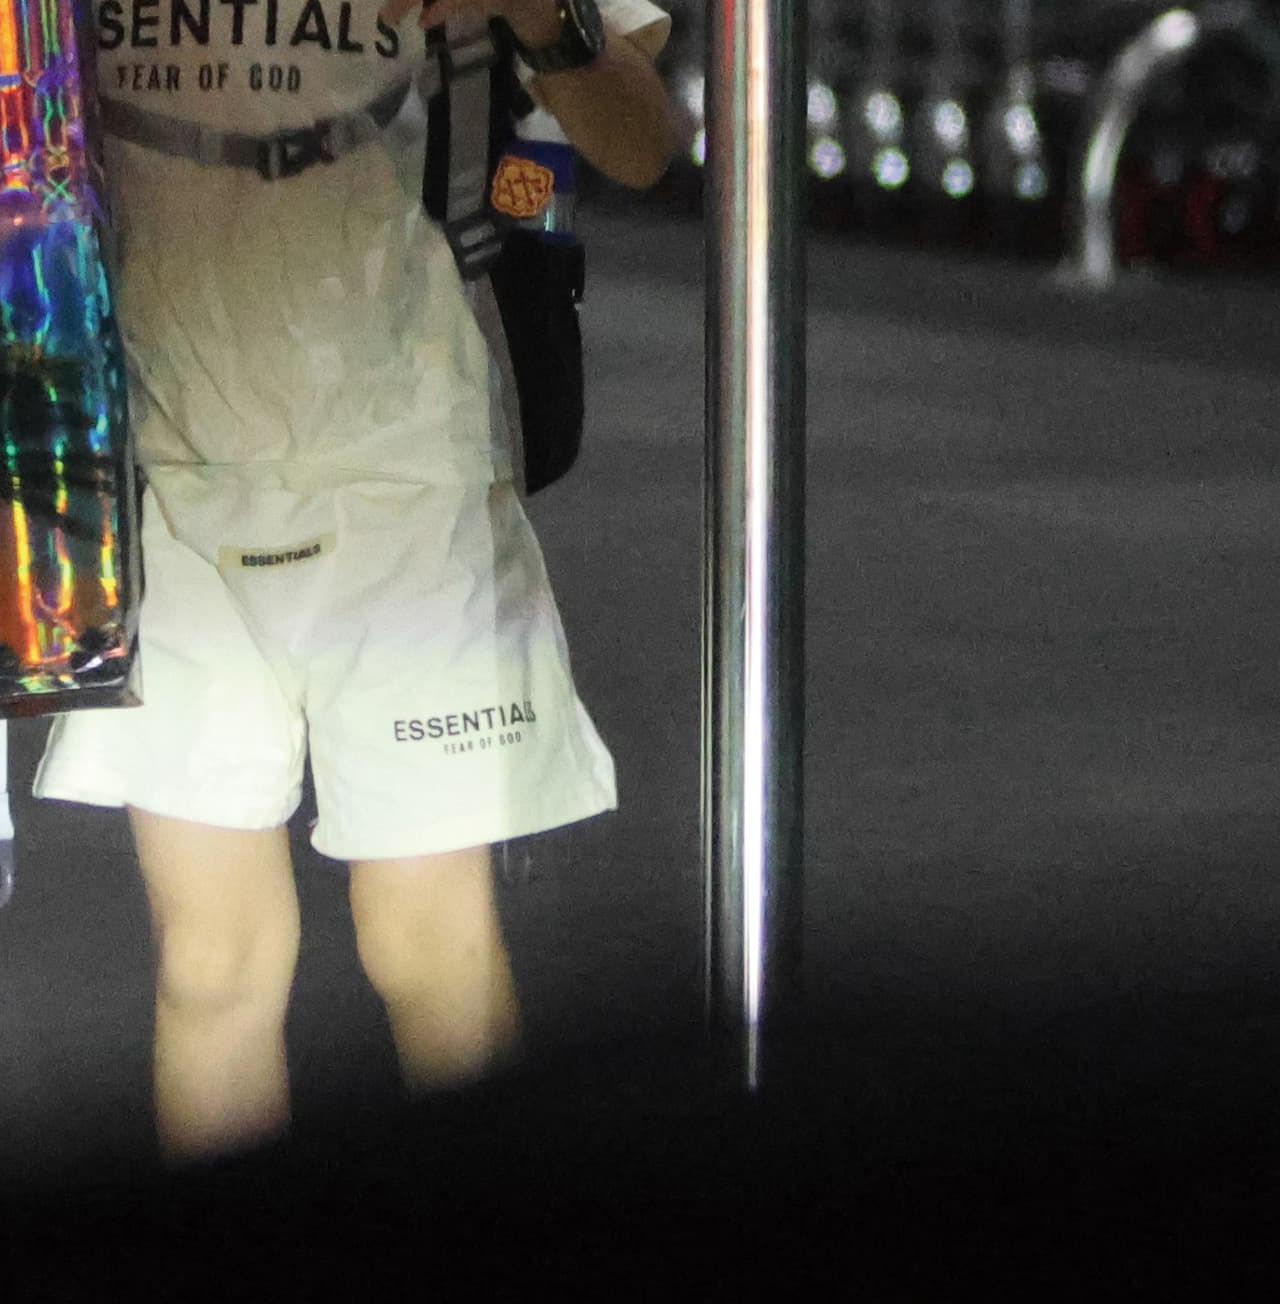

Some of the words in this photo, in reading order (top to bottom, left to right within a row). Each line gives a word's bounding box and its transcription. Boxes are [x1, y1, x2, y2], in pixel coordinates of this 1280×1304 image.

[117, 62, 181, 93] FEAR
[198, 62, 229, 90] OF
[249, 61, 302, 92] GOD
[241, 543, 321, 567] ESSENTIALS
